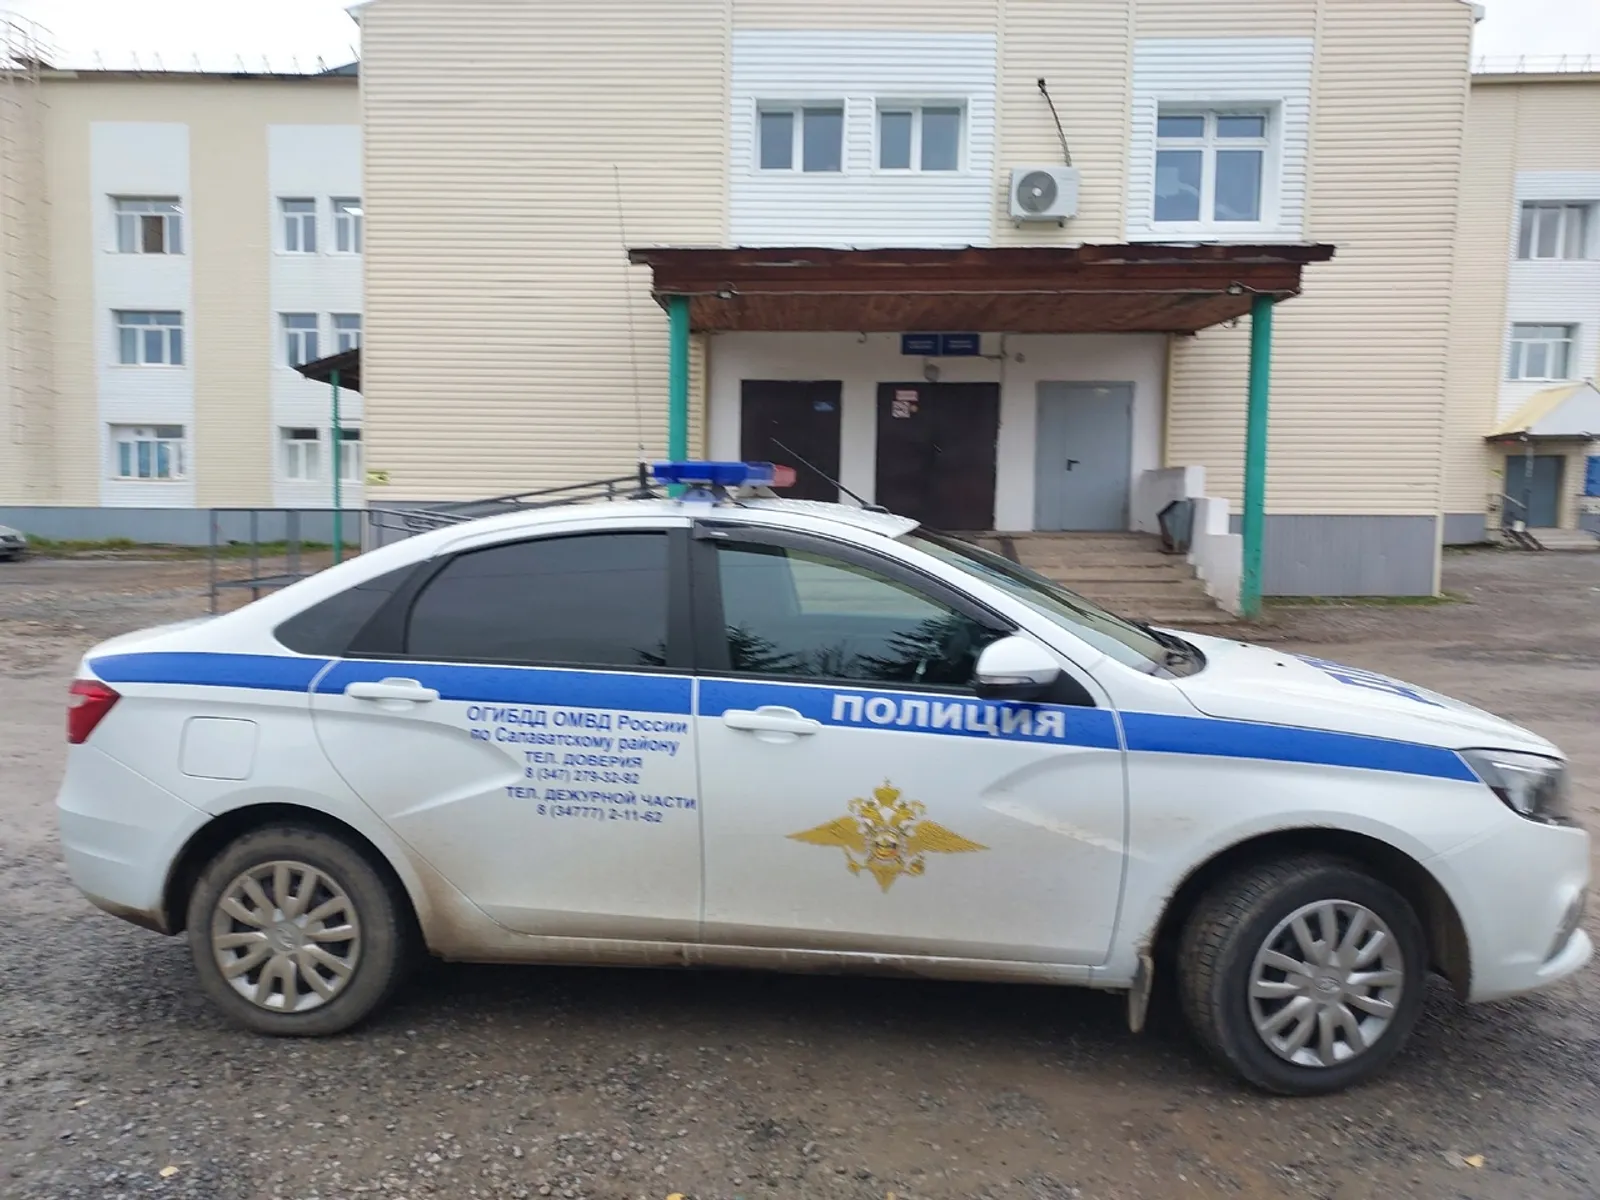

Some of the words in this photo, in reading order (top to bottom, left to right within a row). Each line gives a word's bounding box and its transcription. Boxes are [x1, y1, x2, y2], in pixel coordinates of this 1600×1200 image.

[466, 706, 548, 728] ОГИБДД
[553, 711, 612, 731] ОМВД
[617, 715, 689, 735] России
[831, 694, 1066, 738] ПОЛИЦИЯ
[470, 729, 490, 741] по
[495, 727, 614, 752] Салаватскому
[618, 734, 680, 757] району
[525, 751, 558, 765] ТЕЛ.
[563, 753, 643, 768] ДОВЕРИЯ
[525, 767, 534, 779] 8
[537, 768, 571, 781] (347)
[574, 770, 640, 785] 279-32-92
[506, 786, 538, 799] ТЕЛ.
[544, 788, 637, 806] ДЕЖУРНОЙ
[641, 795, 697, 809] ЧАСТИ
[537, 804, 547, 816] 8
[550, 805, 604, 821] (34777)
[608, 808, 663, 824] 2-11-62
